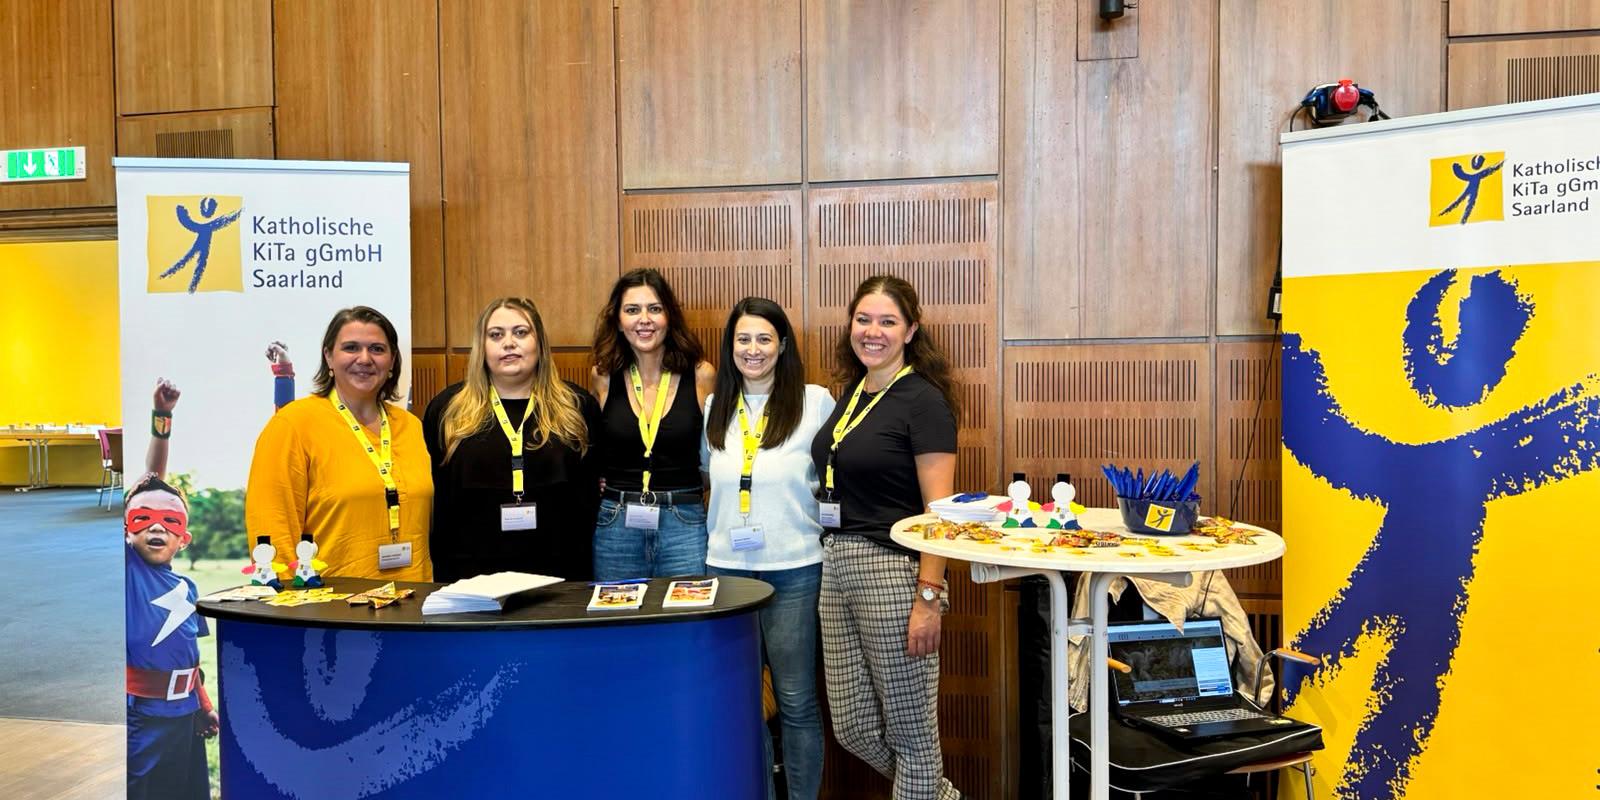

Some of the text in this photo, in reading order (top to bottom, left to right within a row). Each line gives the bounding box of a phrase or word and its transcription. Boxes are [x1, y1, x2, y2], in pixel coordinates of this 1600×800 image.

[1513, 181, 1549, 198] KiTa
[1512, 197, 1589, 217] Saarland
[252, 215, 374, 236] Katholische
[253, 242, 383, 267] KiTa gGmbH
[252, 269, 343, 289] Saarland
